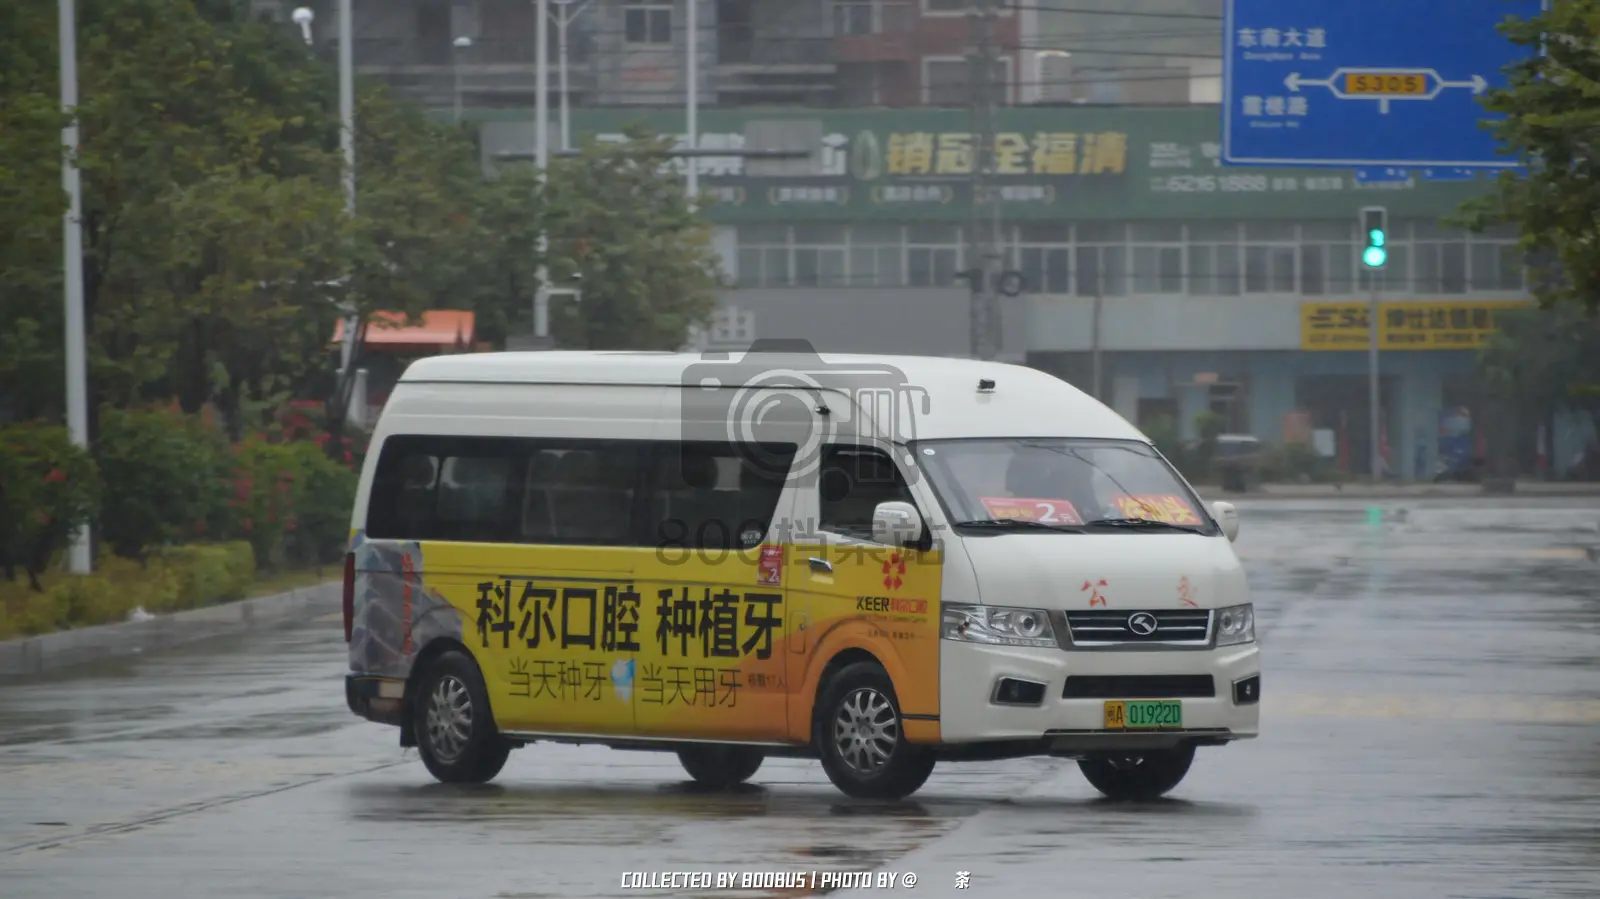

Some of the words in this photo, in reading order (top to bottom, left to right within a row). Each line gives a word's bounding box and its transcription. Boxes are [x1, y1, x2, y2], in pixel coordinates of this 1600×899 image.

[1236, 28, 1327, 48] 东南大道
[476, 580, 642, 652] 科尔口腔
[656, 586, 783, 660] 种植牙
[856, 596, 890, 612] KEER
[508, 656, 607, 701] 当天种牙
[641, 662, 743, 708] 当天用牙
